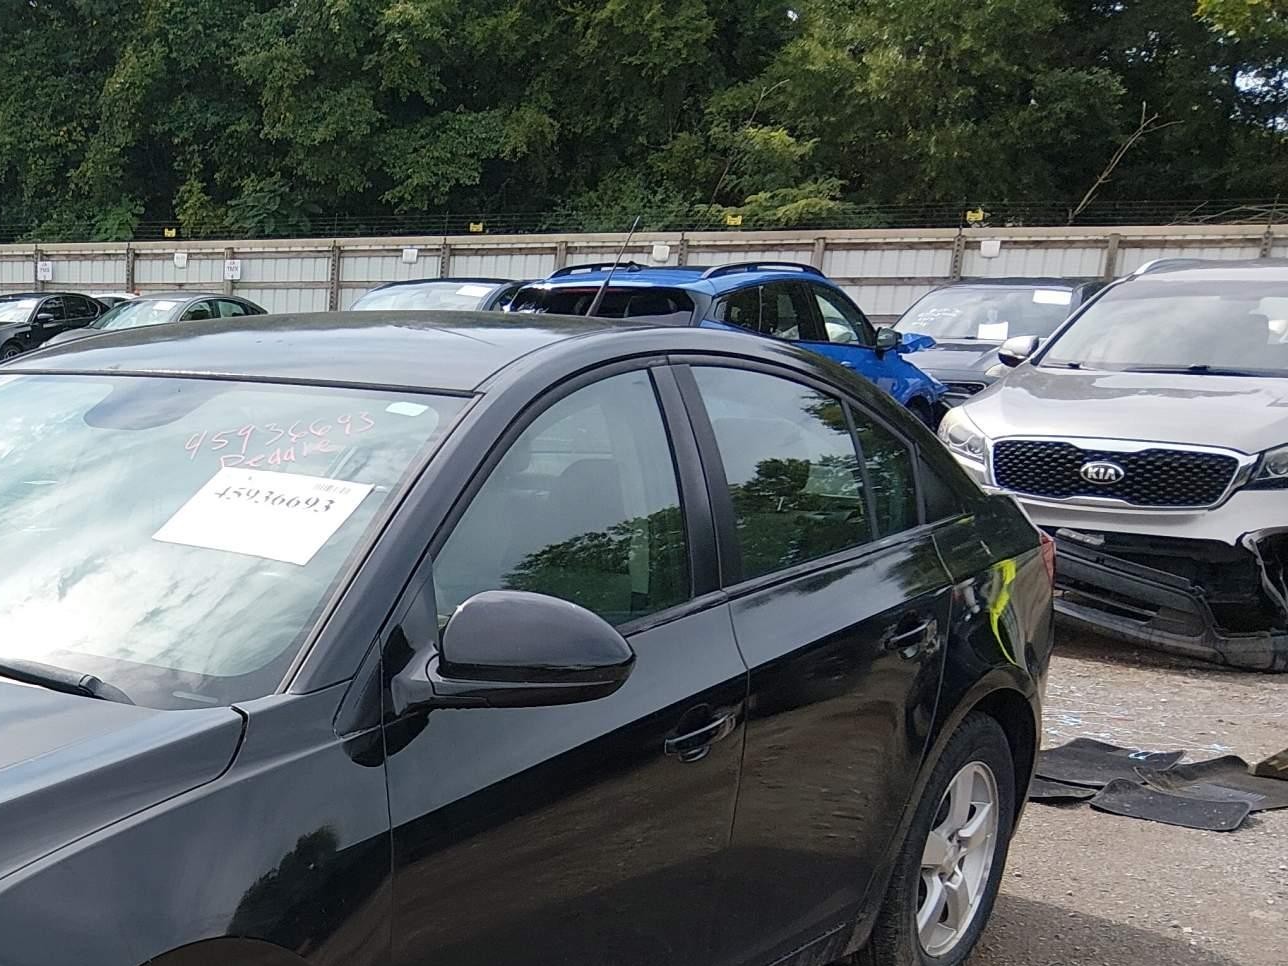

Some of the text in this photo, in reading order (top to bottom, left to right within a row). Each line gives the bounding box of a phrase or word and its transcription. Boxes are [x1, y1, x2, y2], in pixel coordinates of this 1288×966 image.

[185, 411, 375, 459] 45936693
[1087, 467, 1115, 480] KIA
[214, 485, 336, 513] 45936693
